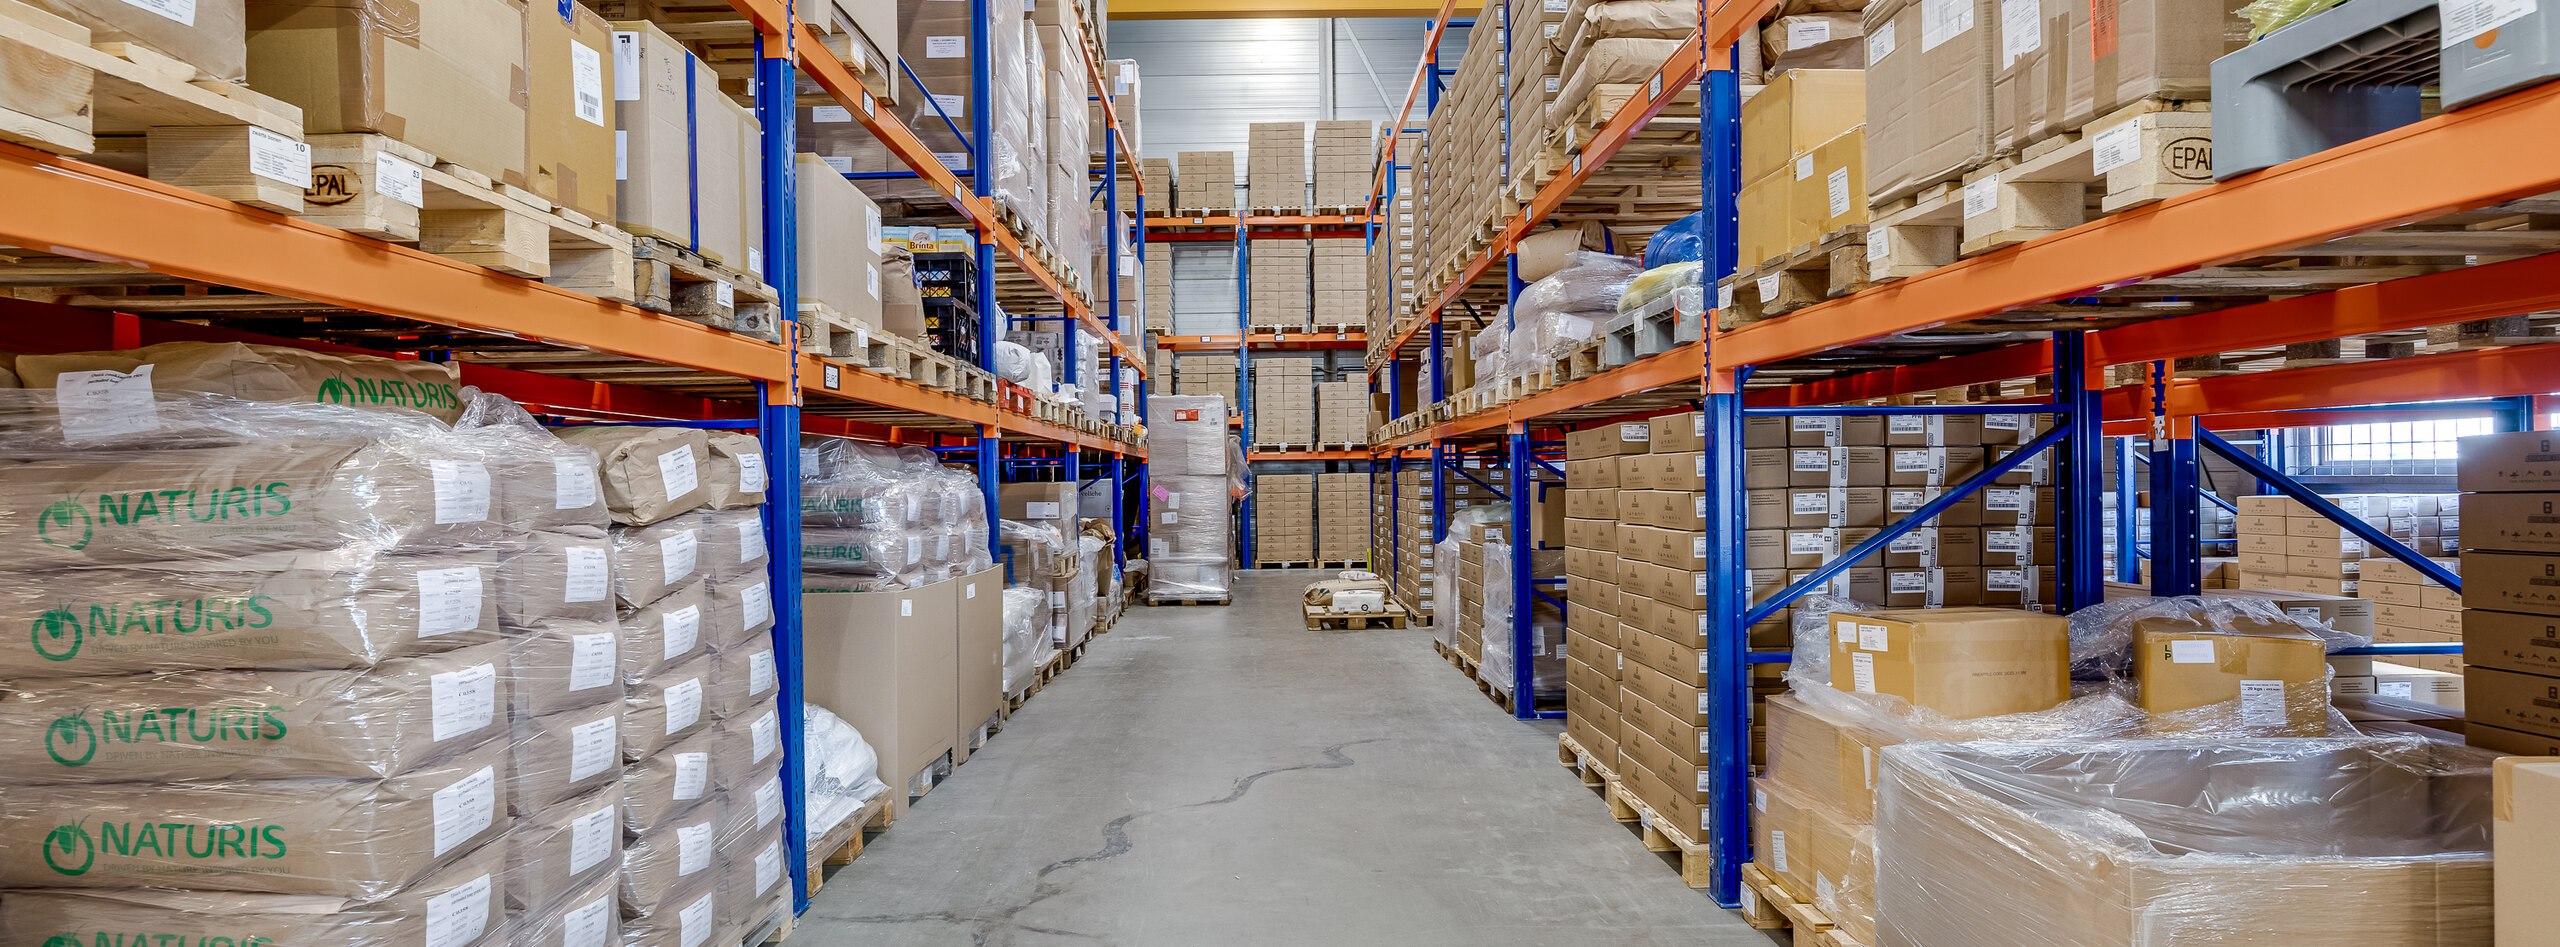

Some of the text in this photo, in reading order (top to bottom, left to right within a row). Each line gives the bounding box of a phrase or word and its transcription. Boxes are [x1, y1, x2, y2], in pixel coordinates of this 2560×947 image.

[2133, 119, 2138, 128] 2
[295, 143, 306, 153] 10
[412, 170, 420, 180] 53
[910, 241, 934, 250] Brinta
[353, 377, 457, 410] NATURIS
[99, 482, 291, 527] NATURIS
[802, 545, 862, 561] ATURIS
[89, 594, 273, 637] NATURIS
[254, 635, 279, 645] YOU
[2165, 644, 2171, 652] L
[102, 706, 287, 744] NATURIS
[101, 821, 287, 859] NATURIS
